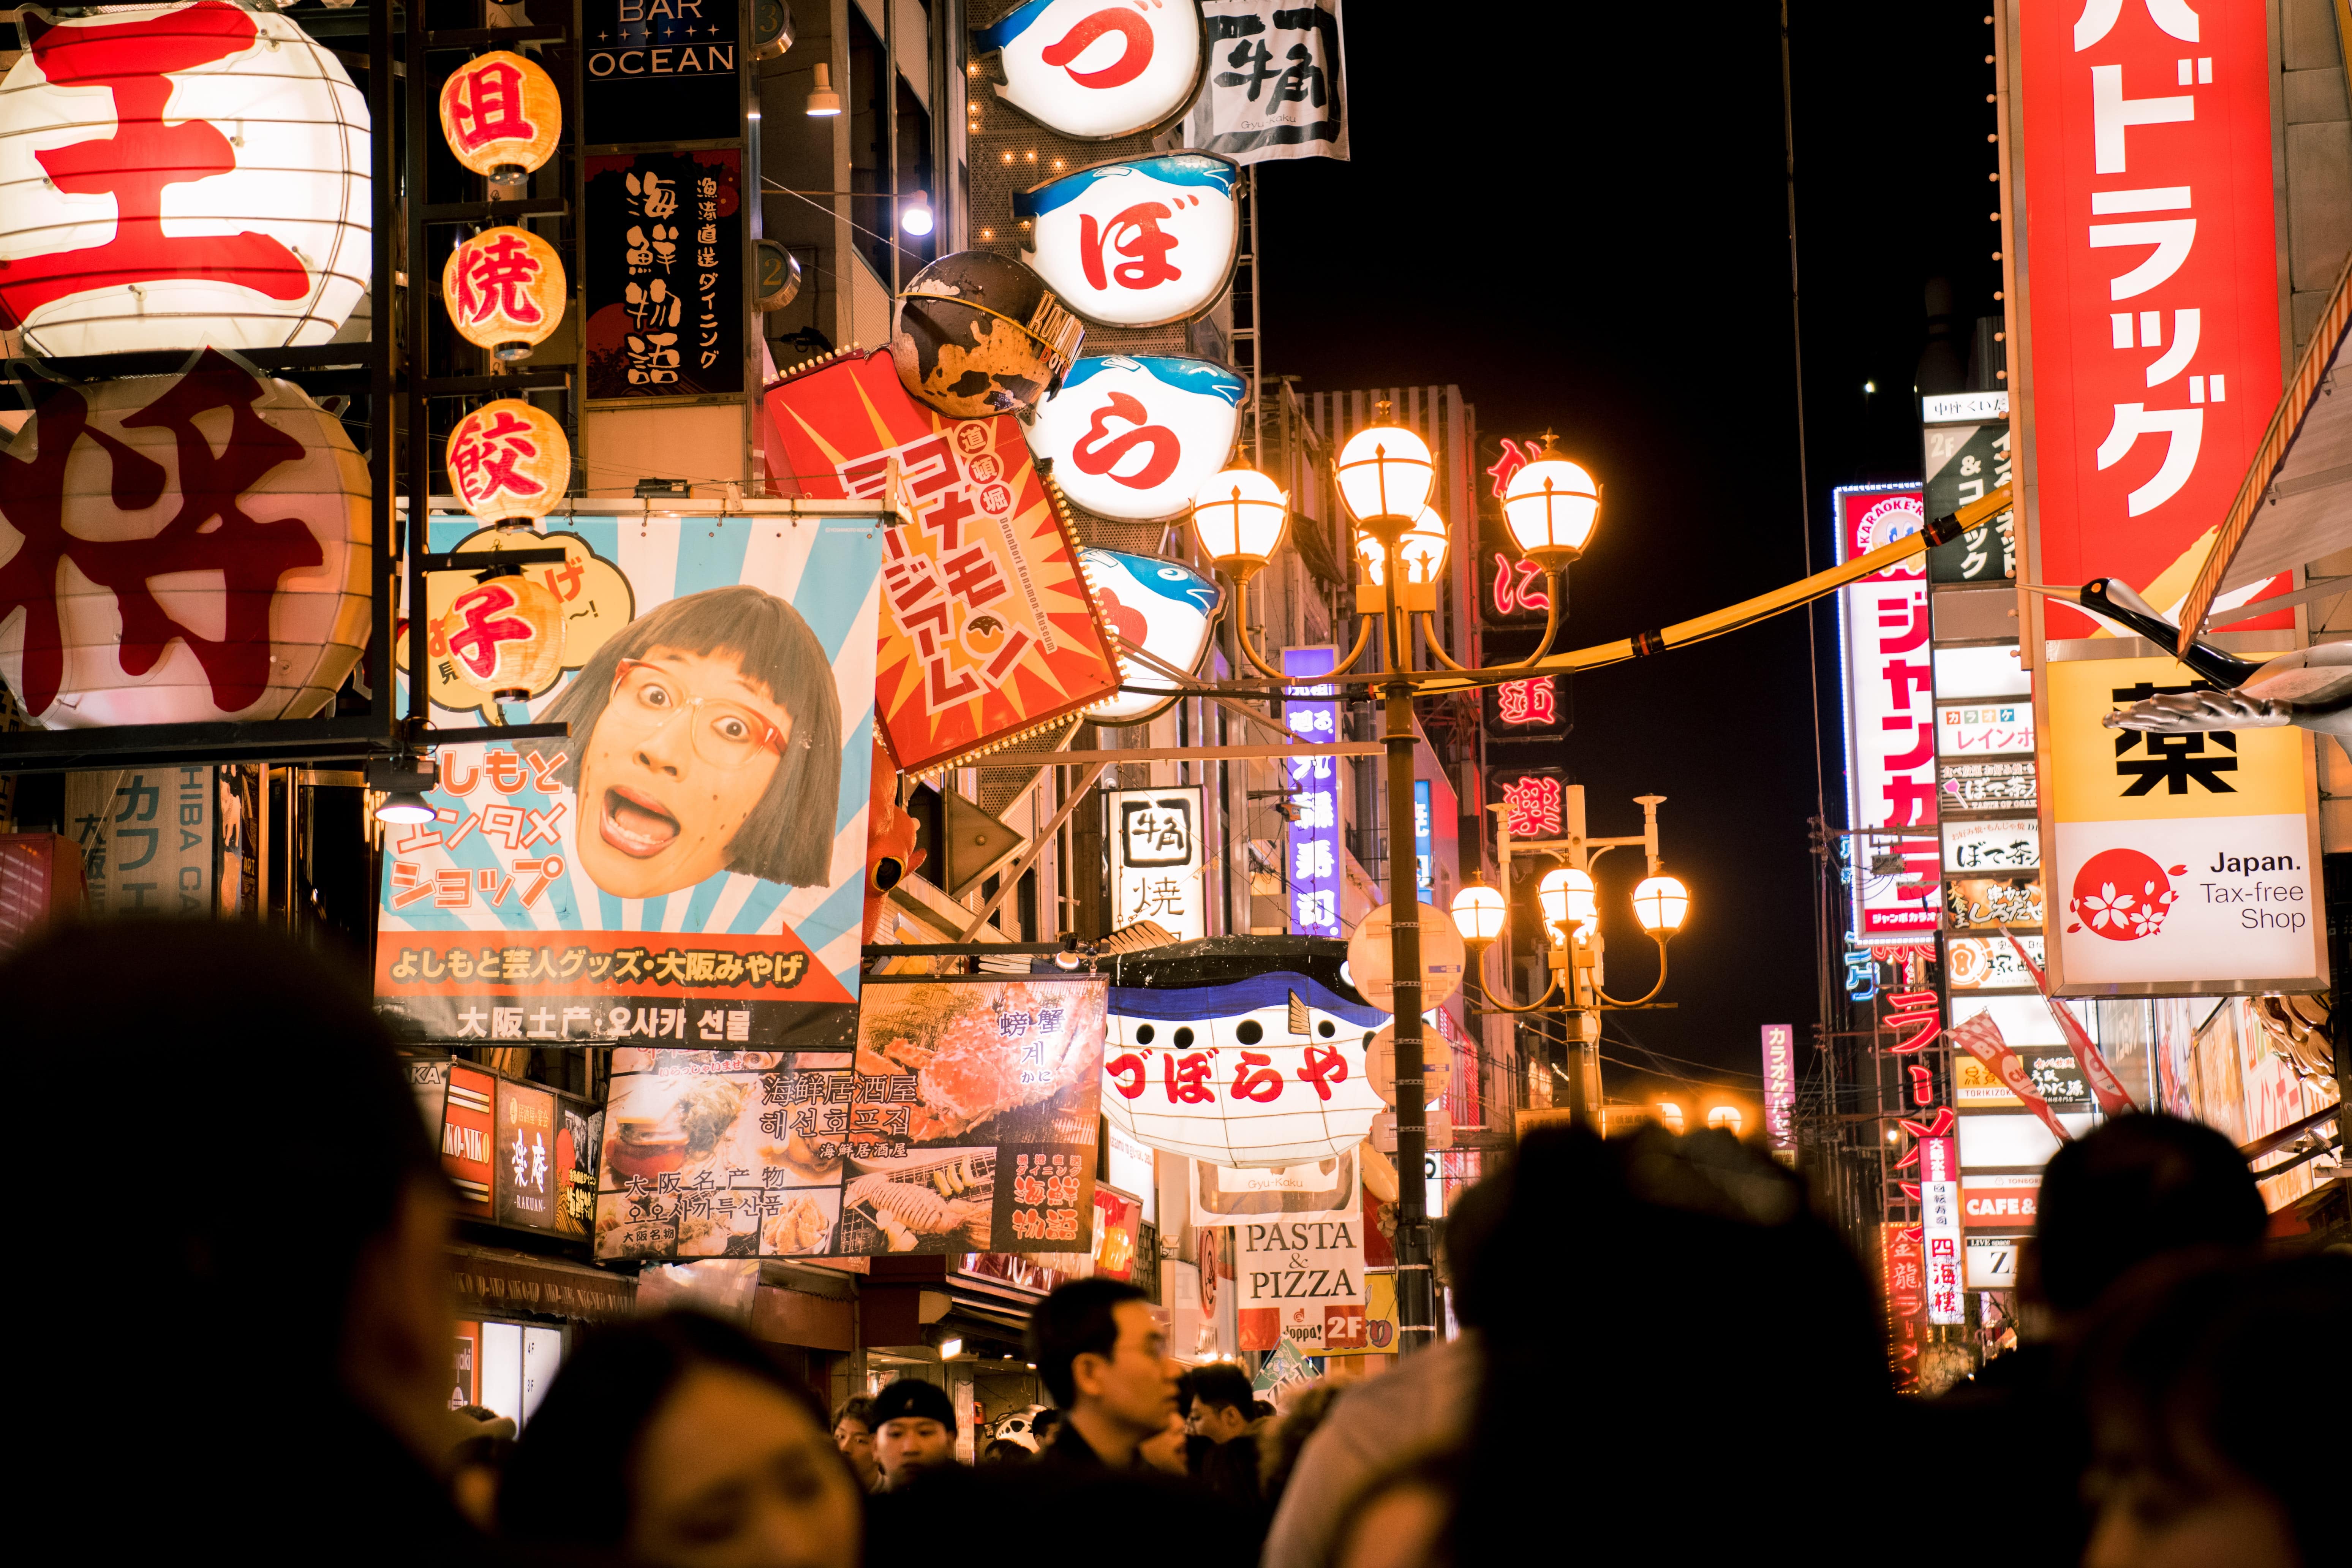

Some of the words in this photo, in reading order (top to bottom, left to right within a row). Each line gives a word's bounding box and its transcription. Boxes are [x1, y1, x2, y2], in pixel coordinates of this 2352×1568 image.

[619, 0, 703, 22] BAR
[760, 3, 778, 32] 3
[589, 46, 733, 76] OCEAN
[1213, 39, 1326, 115] 牛角
[1241, 114, 1296, 130] Gyu-Kaku
[625, 171, 681, 385] 海鮮物語
[697, 177, 719, 369] 漁港直送ダイニング
[763, 258, 781, 286] 2
[1930, 433, 1954, 458] 2F
[959, 425, 1009, 512] 道頓堀
[1959, 455, 1988, 579] &コック
[843, 455, 973, 707] ミージアム
[1000, 517, 1024, 564] Dotonbori
[1018, 565, 1055, 651] Konamon-Museum
[1947, 708, 2014, 725] カラオケ
[418, 748, 569, 797] しもと
[1971, 801, 1999, 809] TASTE
[2000, 800, 2012, 808] OF
[1132, 811, 1185, 852] 牛角
[2210, 851, 2302, 877] Japan.
[390, 854, 566, 910] ショップ
[1987, 884, 2031, 903] 串かつ
[2200, 882, 2304, 904] Tax-free
[2241, 908, 2306, 933] Shop
[392, 948, 803, 985] よしもと芸人グッズ・大阪みやげ
[1021, 1070, 1053, 1083] かに
[1105, 1045, 1348, 1104] づぼらや
[760, 1106, 910, 1140] 해선호프집
[819, 1142, 908, 1159] 海鮮居酒屋
[1016, 1154, 1082, 1165] 漁港直送
[624, 1166, 786, 1198] 大阪名产物
[1016, 1165, 1082, 1176] ダイニング
[1248, 1178, 1303, 1190] Gyu-Kaku
[567, 1186, 595, 1221] 海鮮物
[1015, 1176, 1080, 1207] 海鮮
[1966, 1198, 2020, 1216] CAFE
[2021, 1197, 2037, 1215] &
[623, 1228, 675, 1243] 大阪名物
[1012, 1208, 1078, 1240] 物語
[1245, 1222, 1357, 1252] PASTA
[1288, 1252, 1309, 1269] &
[1249, 1269, 1356, 1299] PIZZA
[1327, 1316, 1362, 1338] 2F
